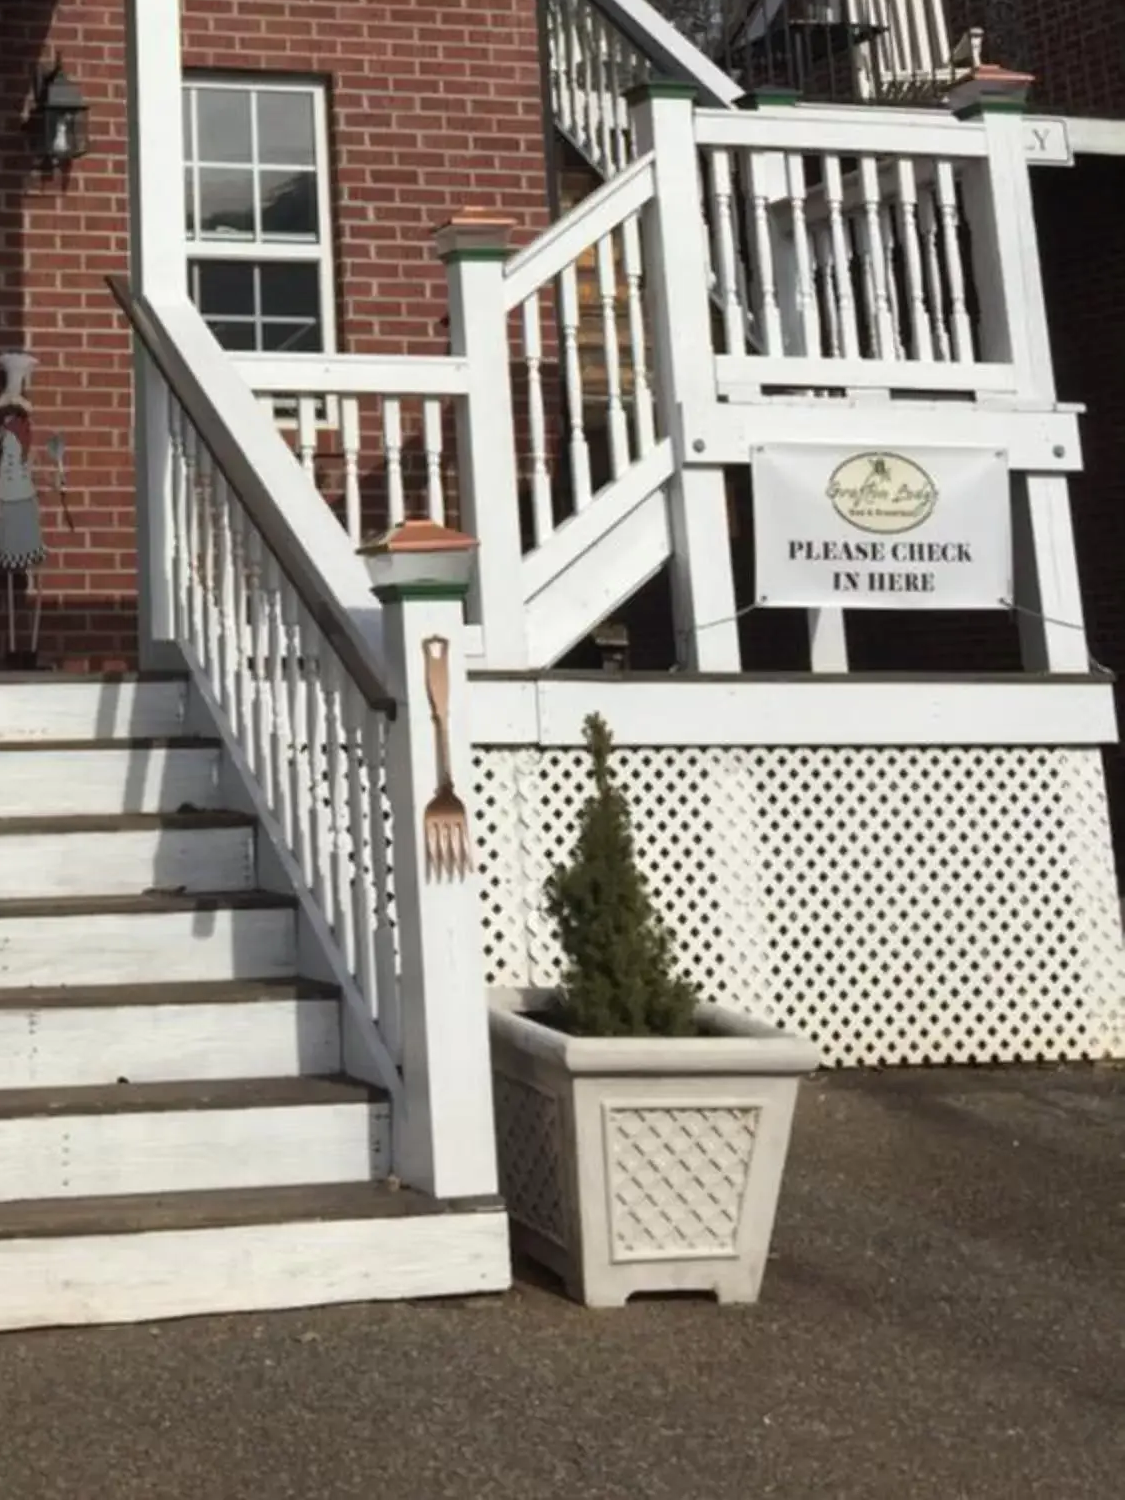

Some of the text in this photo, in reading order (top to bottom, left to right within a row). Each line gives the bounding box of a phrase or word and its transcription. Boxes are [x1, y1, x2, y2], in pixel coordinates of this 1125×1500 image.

[788, 540, 973, 563] PLEASE CHECK
[833, 571, 936, 593] IN HERE
